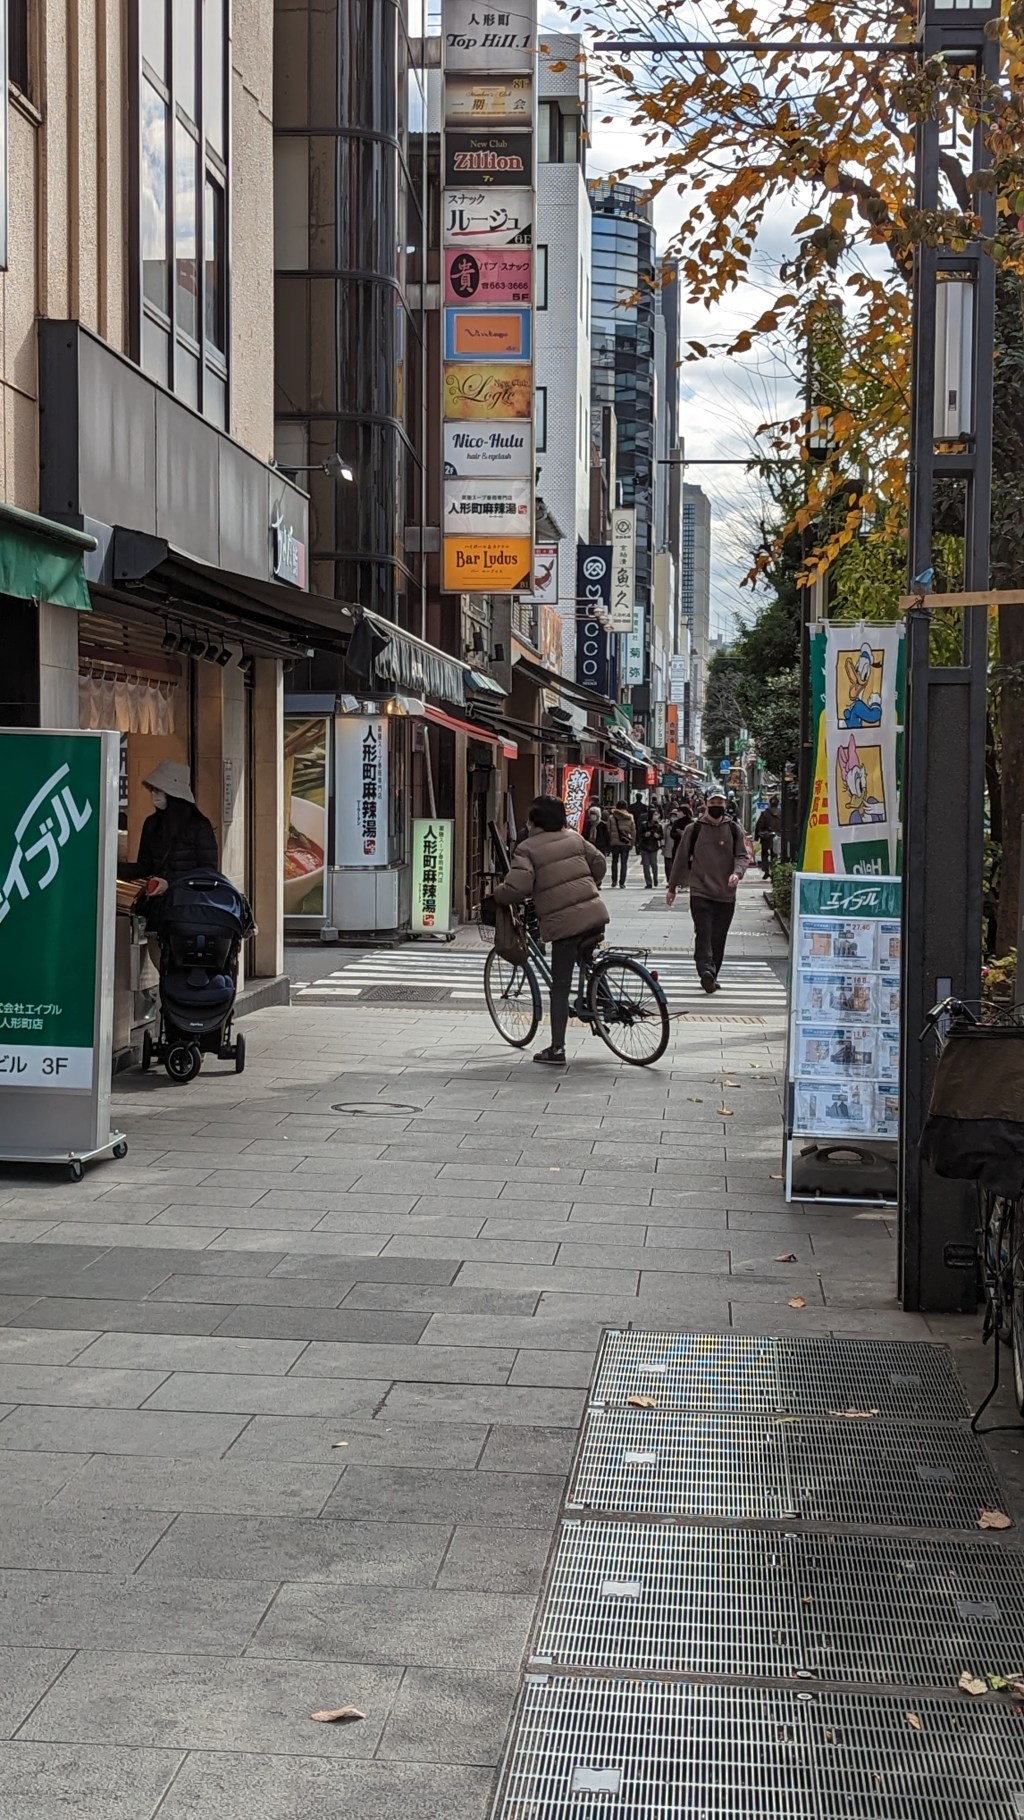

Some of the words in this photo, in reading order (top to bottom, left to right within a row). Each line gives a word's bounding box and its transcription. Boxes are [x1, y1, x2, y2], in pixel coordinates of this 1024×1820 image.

[467, 13, 511, 27] 人形町
[446, 33, 478, 50] Top
[451, 98, 527, 111] 一期一会
[470, 140, 487, 148] New
[489, 140, 508, 148] Club
[453, 151, 524, 171] Zillion
[448, 194, 486, 205] スナック
[446, 208, 522, 232] ルージュ
[450, 258, 476, 293] 貴
[512, 293, 529, 301] 5F
[452, 433, 524, 449] Nico-Hulu
[466, 452, 481, 460] hair
[448, 502, 517, 515] 人形町麻辣湯
[455, 550, 481, 568] Bar
[483, 550, 518, 568] Ludus
[362, 724, 377, 839] 人形町麻辣湯
[422, 824, 438, 914] 人形町麻辣湯
[820, 887, 882, 911] エイブル
[42, 1057, 69, 1075] 3F
